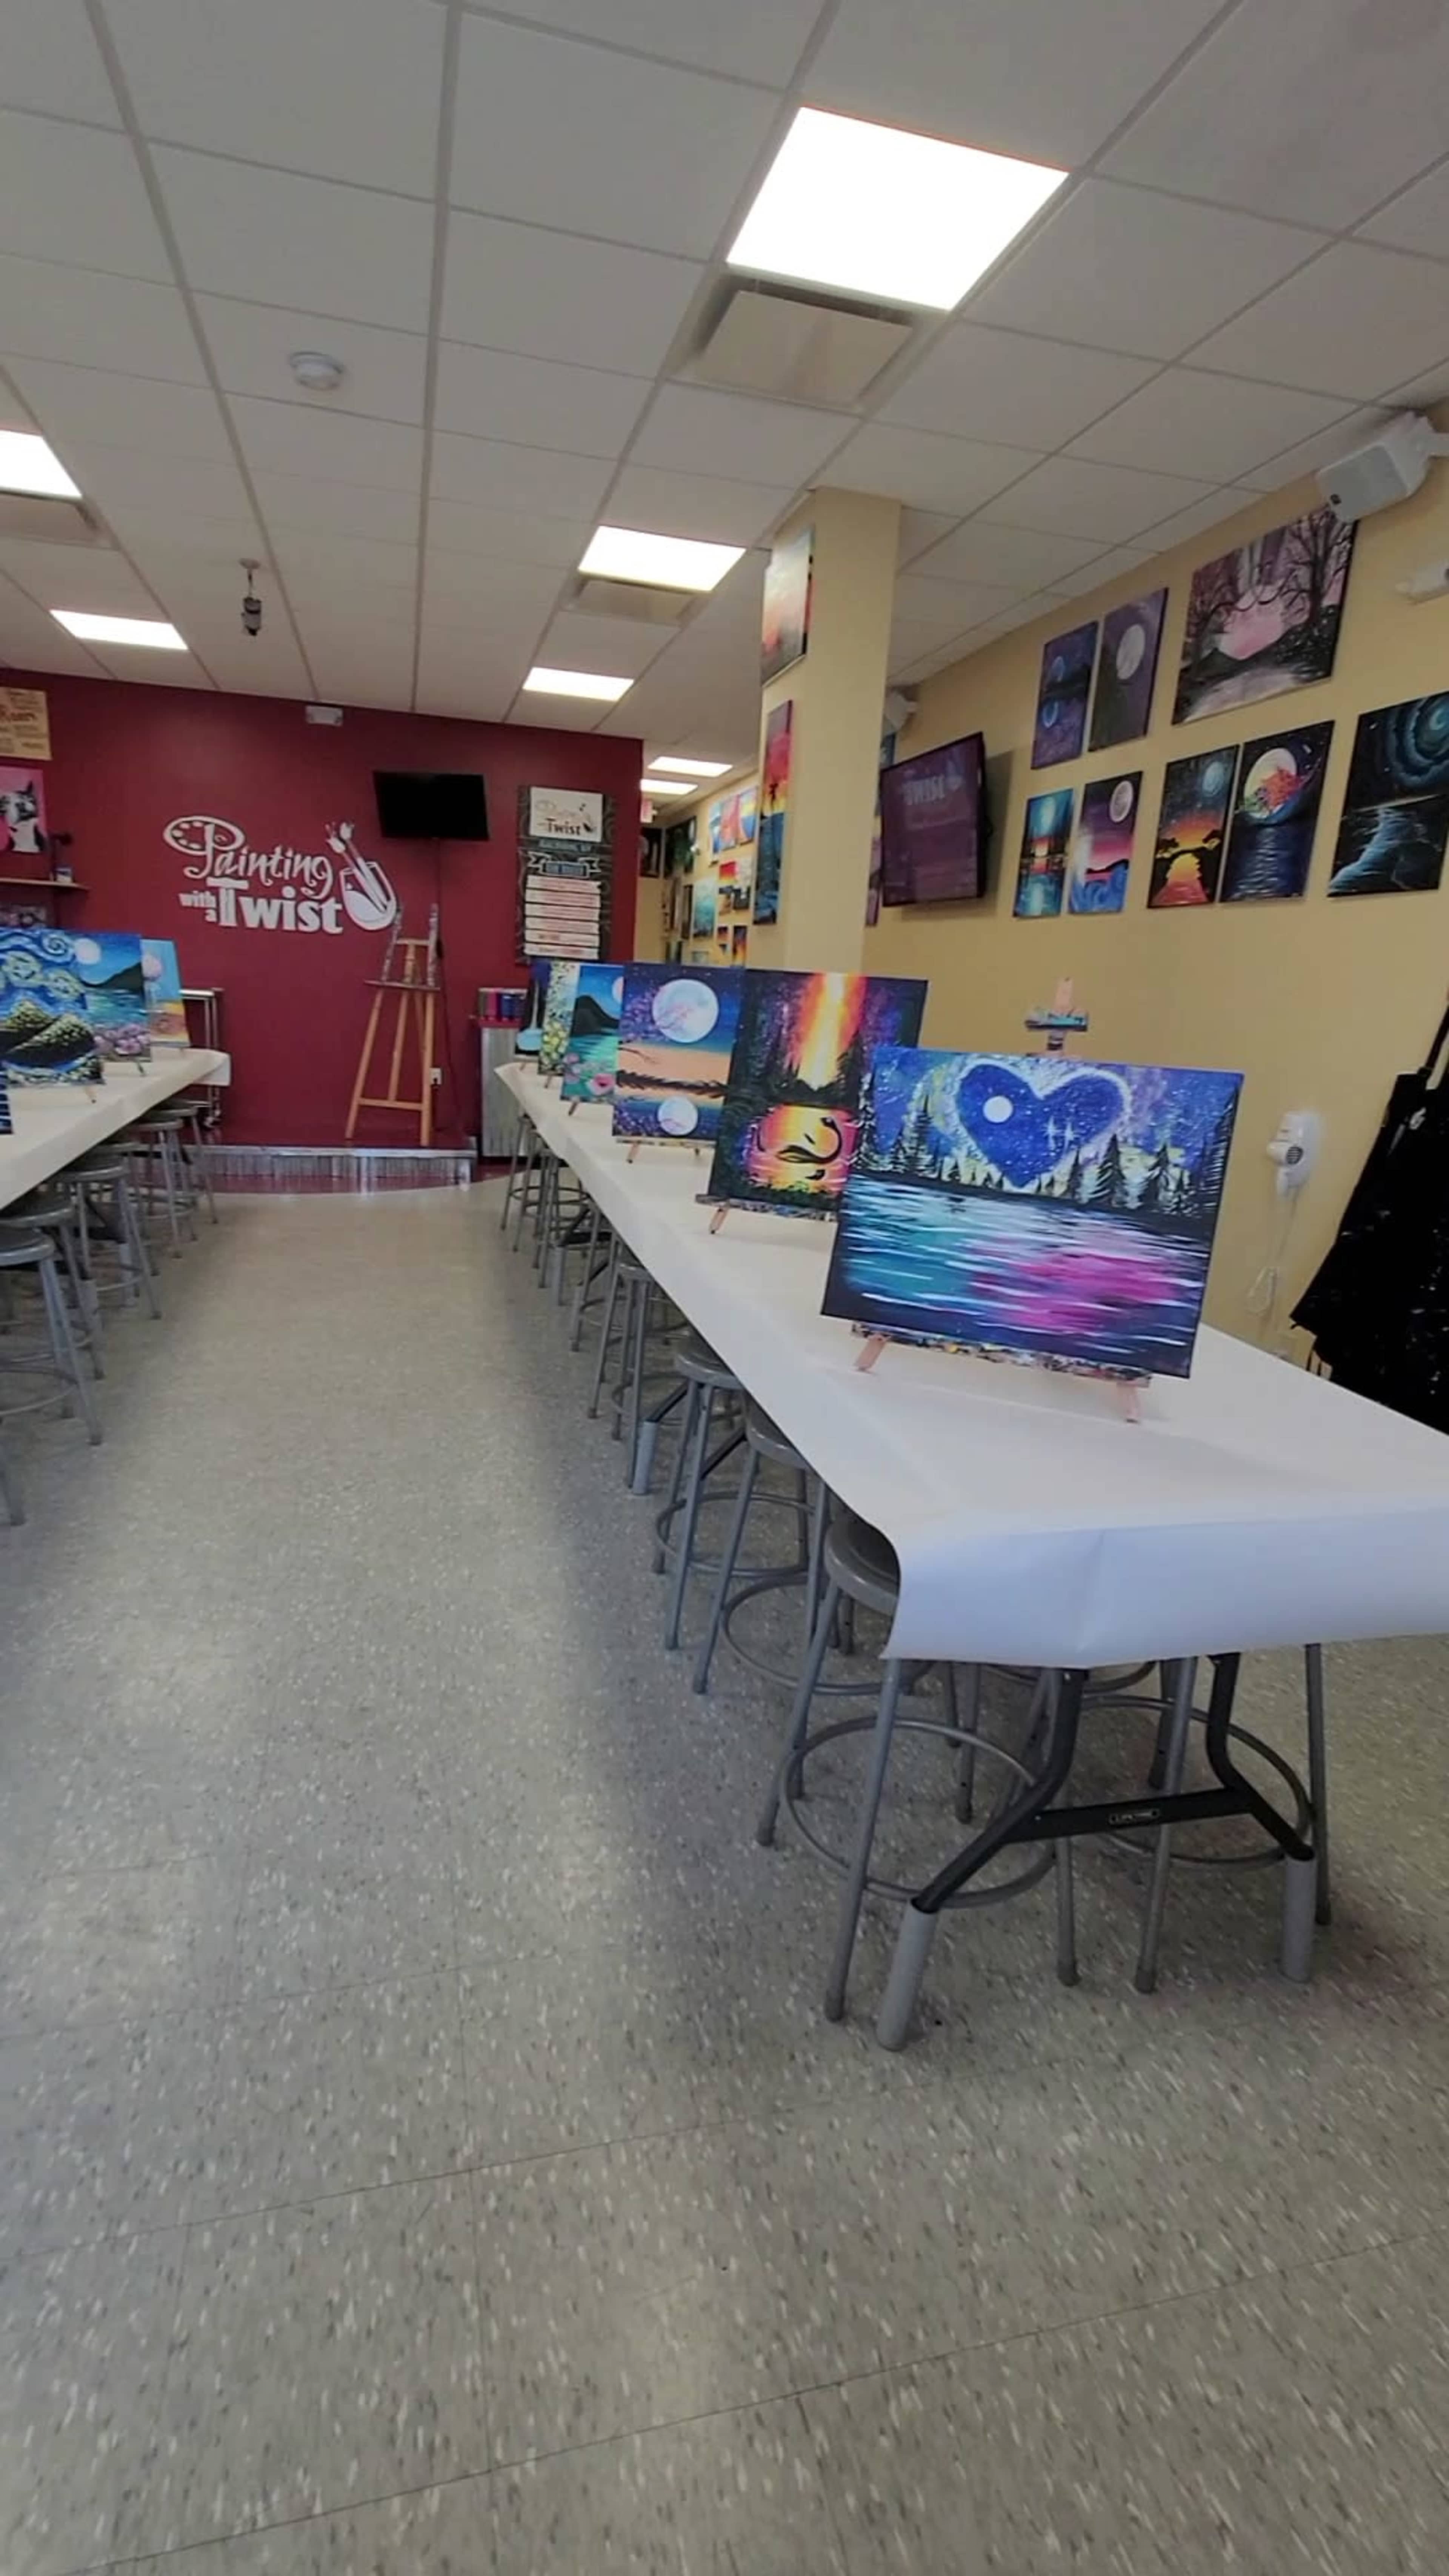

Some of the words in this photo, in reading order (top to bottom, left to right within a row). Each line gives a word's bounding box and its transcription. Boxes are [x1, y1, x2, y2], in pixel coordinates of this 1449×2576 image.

[545, 817, 581, 836] Twist
[163, 816, 333, 899] Painting
[178, 890, 216, 908] with
[206, 877, 343, 934] Twist
[205, 907, 217, 922] a
